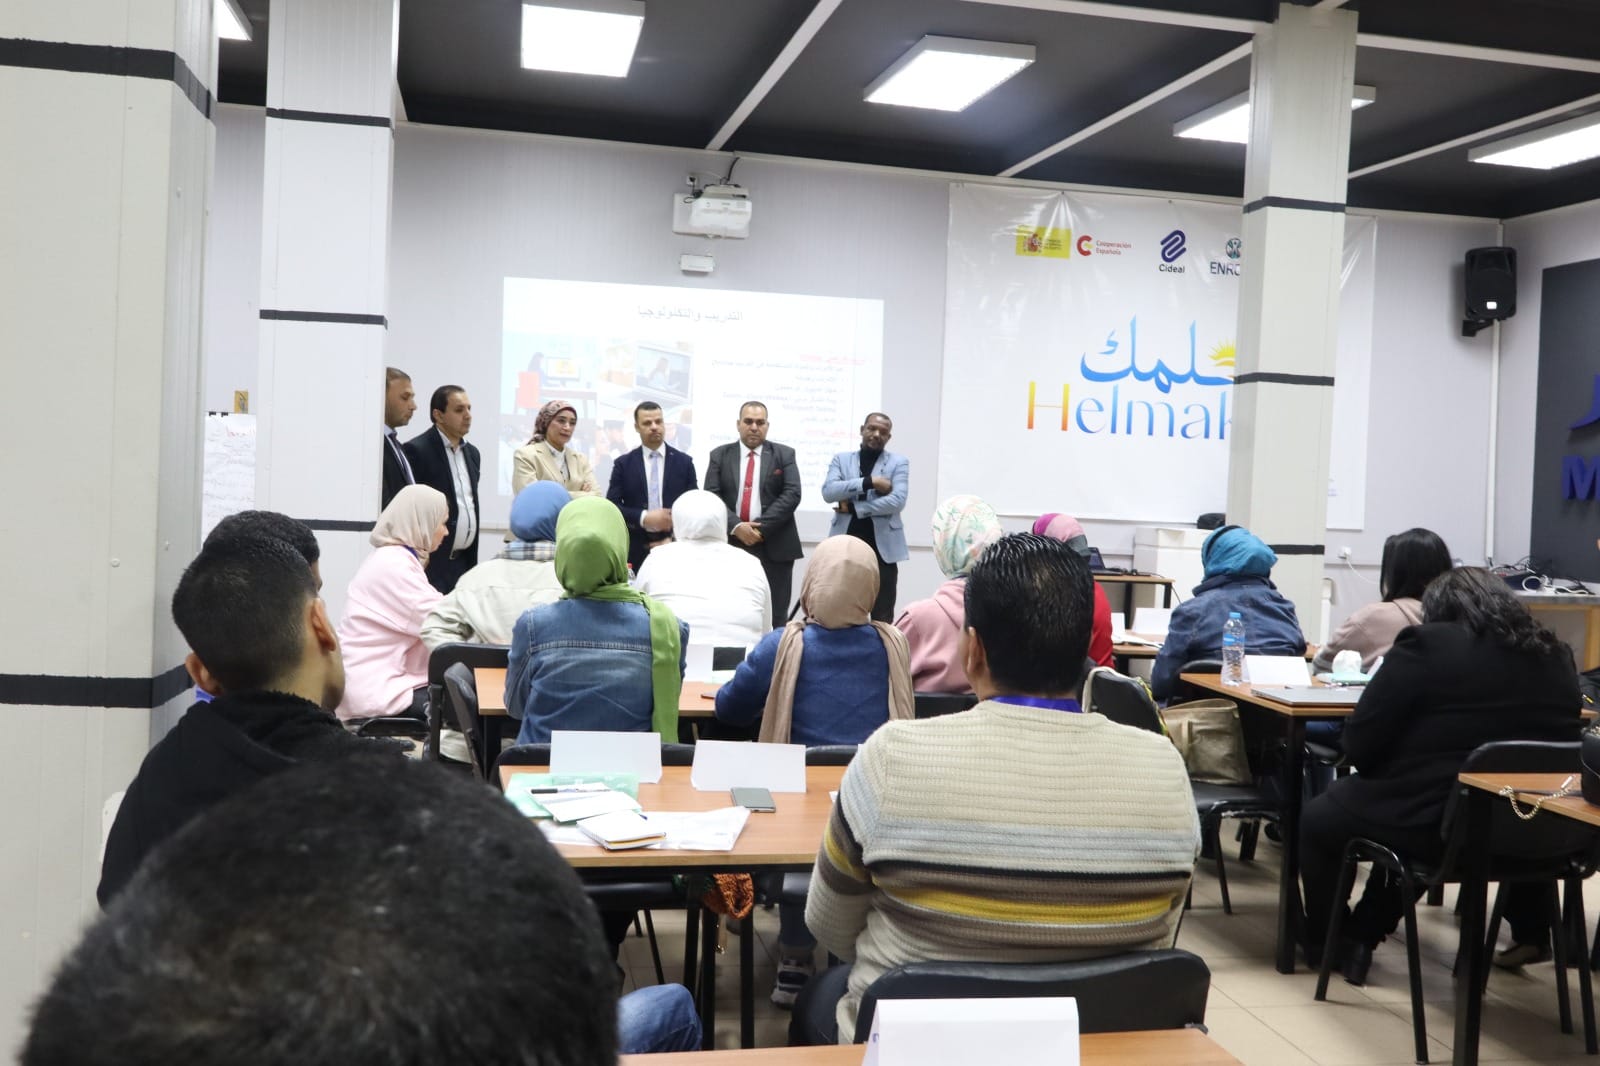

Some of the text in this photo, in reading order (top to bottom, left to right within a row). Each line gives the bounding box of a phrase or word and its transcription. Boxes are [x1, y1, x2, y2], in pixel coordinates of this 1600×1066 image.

[1095, 240, 1132, 249] Cooperación
[1095, 247, 1122, 256] Española
[1159, 263, 1185, 273] Cideal
